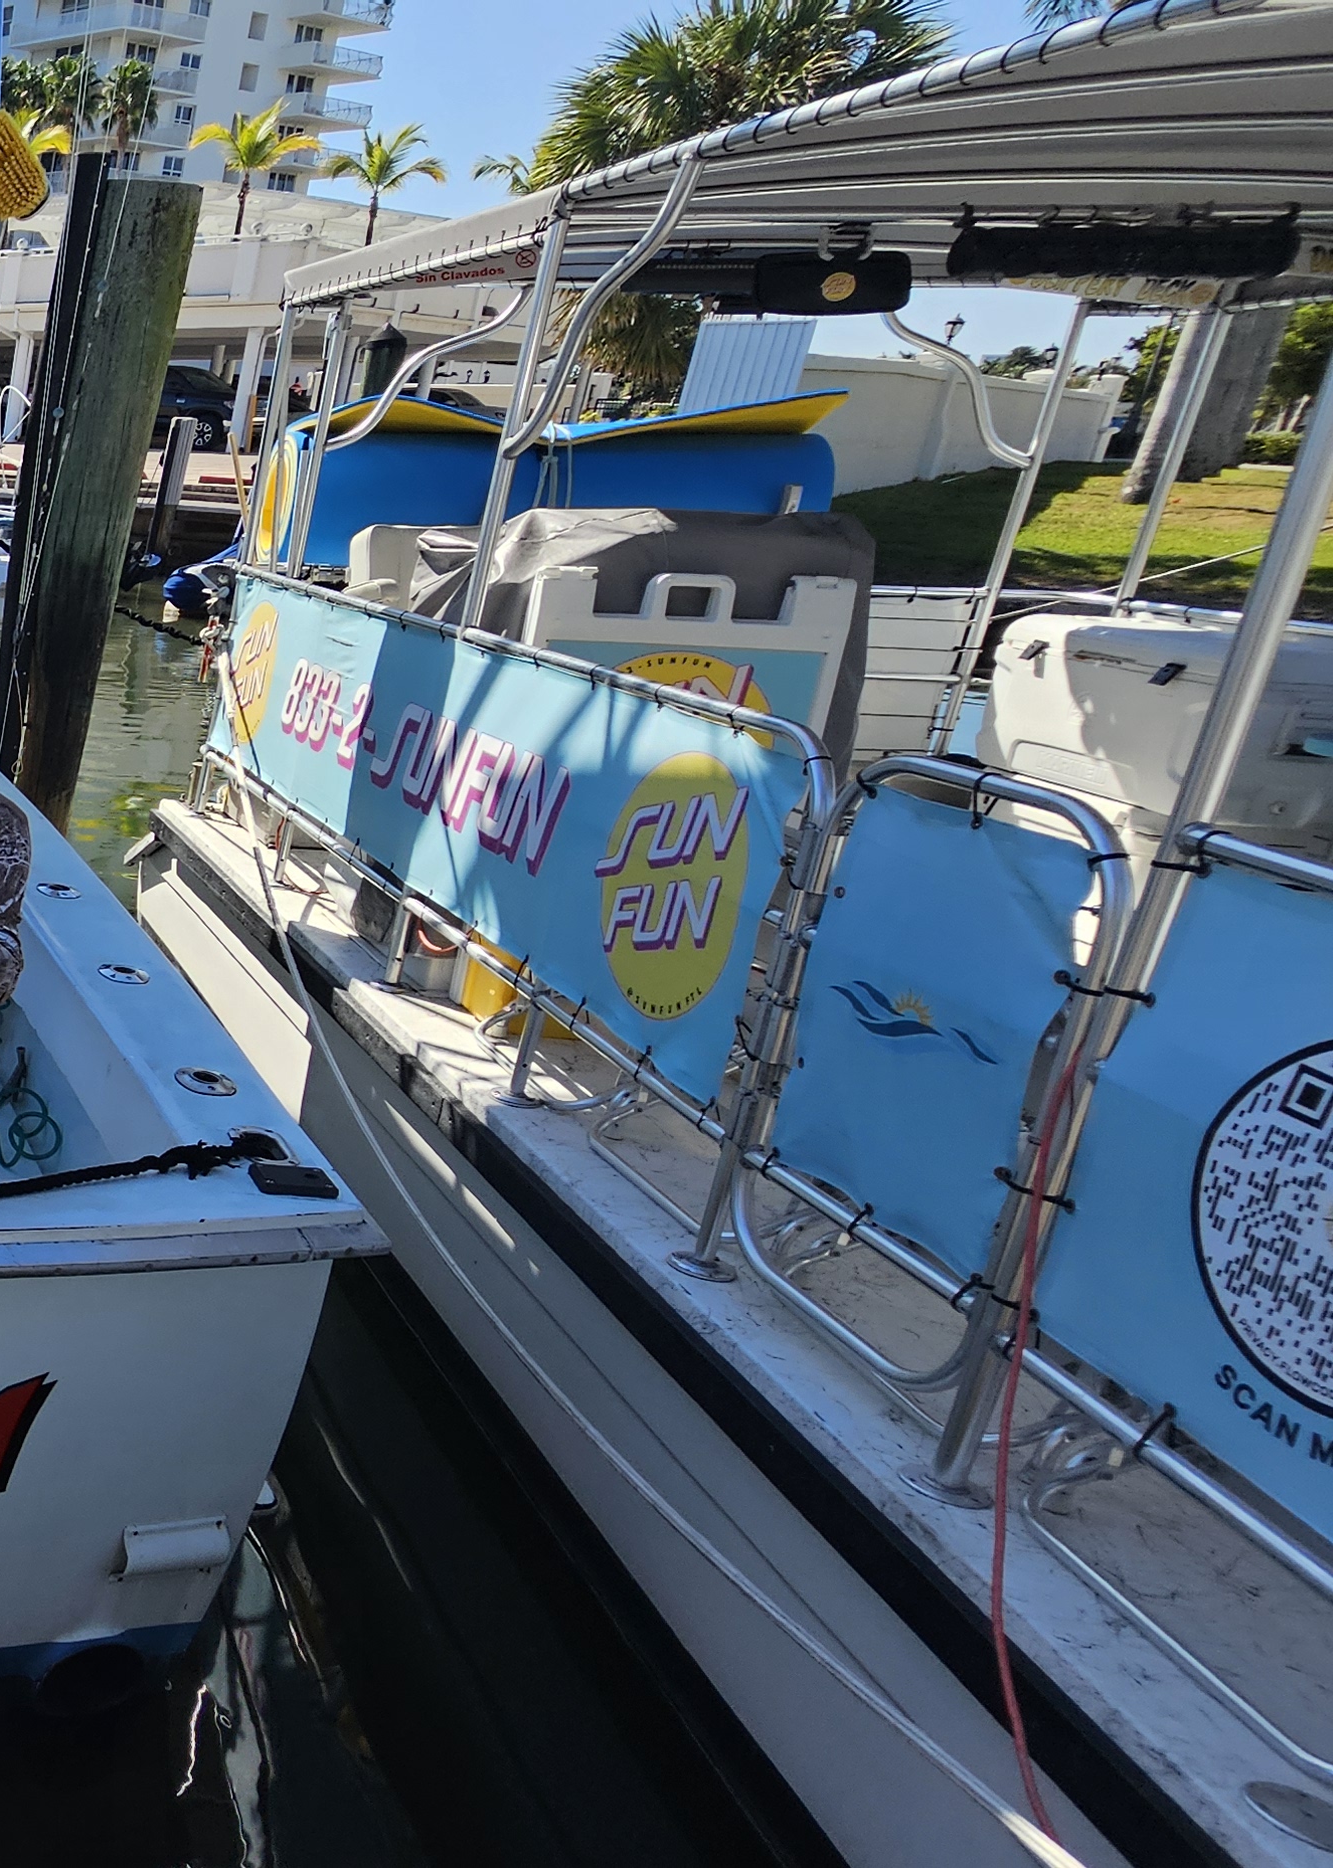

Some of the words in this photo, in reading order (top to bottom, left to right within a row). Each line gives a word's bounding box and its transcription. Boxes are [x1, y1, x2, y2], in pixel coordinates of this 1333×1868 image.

[415, 273, 437, 284] Sin
[440, 267, 506, 282] Clavados
[231, 611, 280, 678] SUN
[281, 656, 572, 879] 833-2-SUNFUN
[594, 785, 750, 879] SUN
[603, 874, 723, 953] FUN
[1214, 1364, 1302, 1449] SCAN
